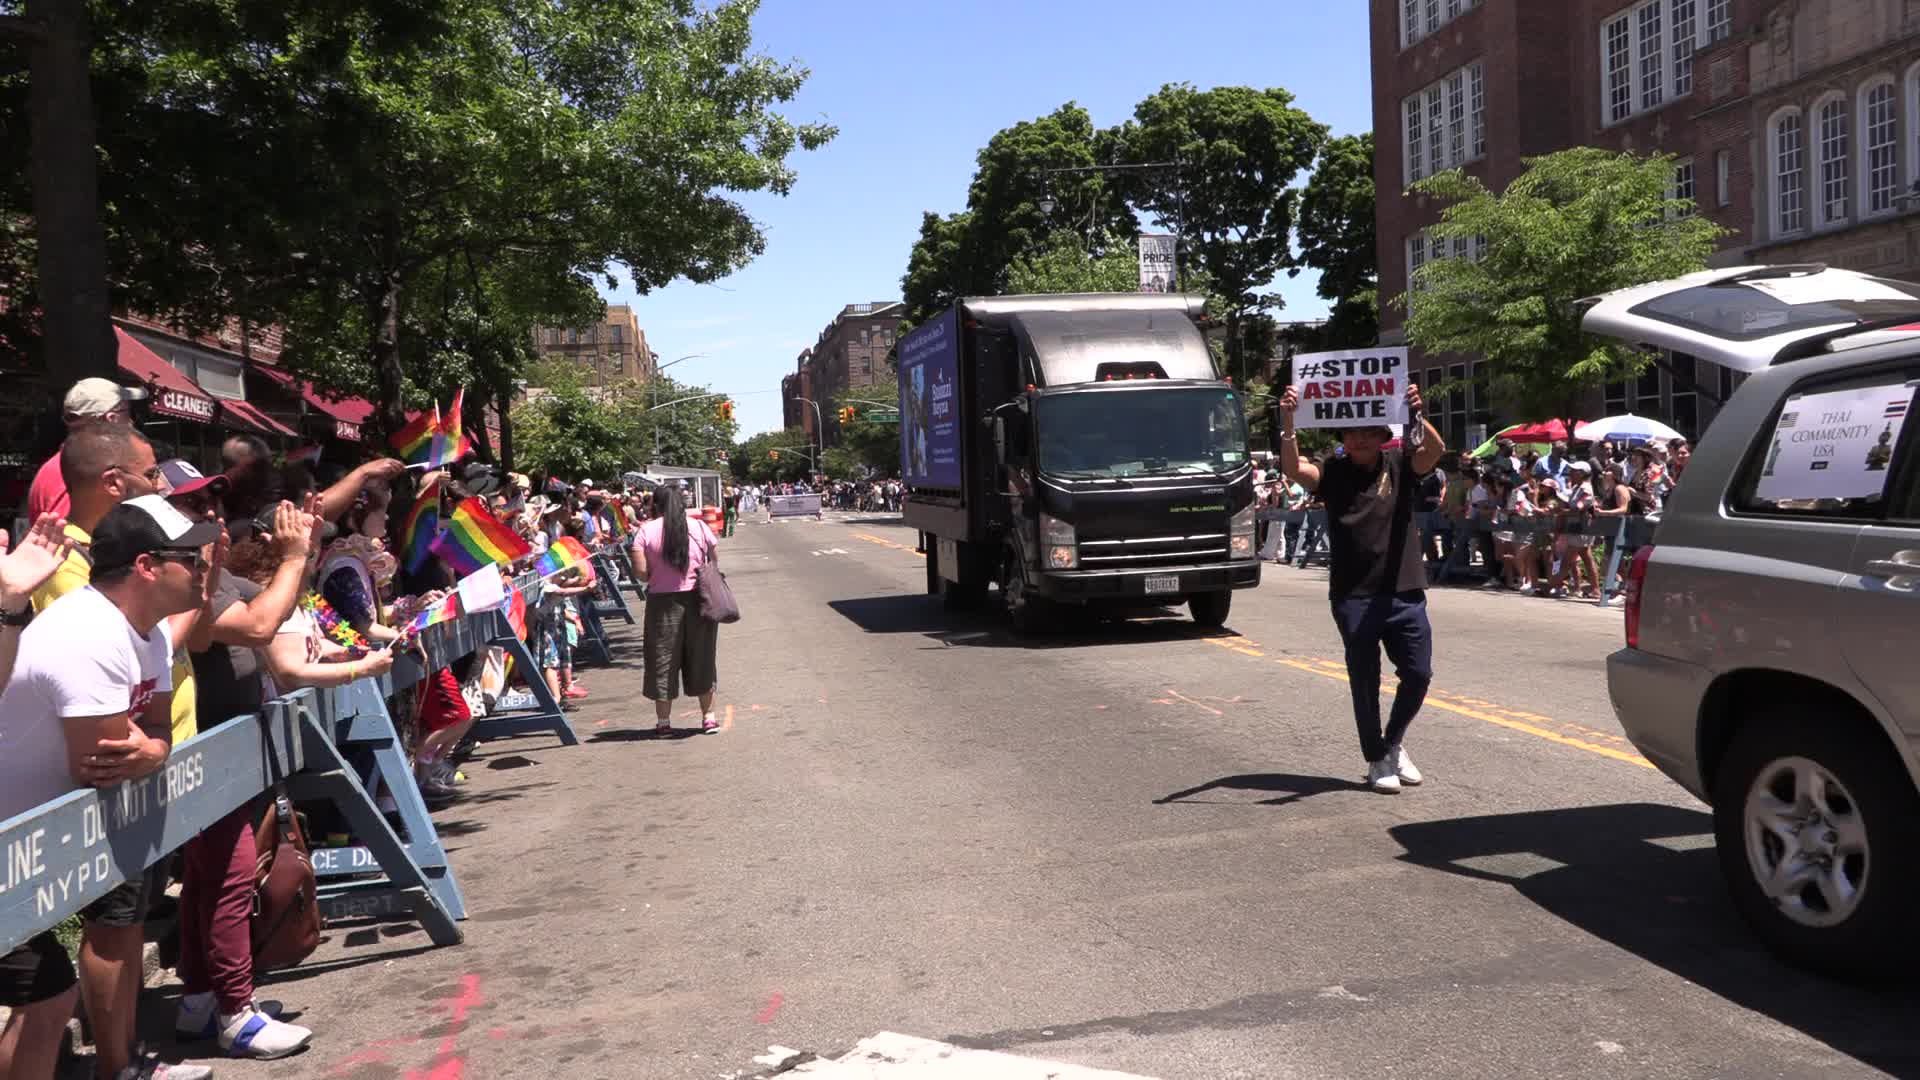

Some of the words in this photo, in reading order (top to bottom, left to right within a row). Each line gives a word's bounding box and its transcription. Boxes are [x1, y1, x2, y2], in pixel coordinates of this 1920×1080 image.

[1143, 253, 1172, 264] PRIDE
[1298, 356, 1401, 380] #STOP
[1303, 377, 1395, 400] ASIAN
[163, 391, 215, 417] CLEANERS
[1314, 400, 1387, 420] HATE
[1820, 410, 1852, 425] THAI
[1791, 424, 1873, 444] COMMUNITY
[502, 694, 533, 708] DEPT
[0, 828, 46, 894] INE
[157, 751, 204, 807] CROSS
[36, 852, 110, 917] NYPD
